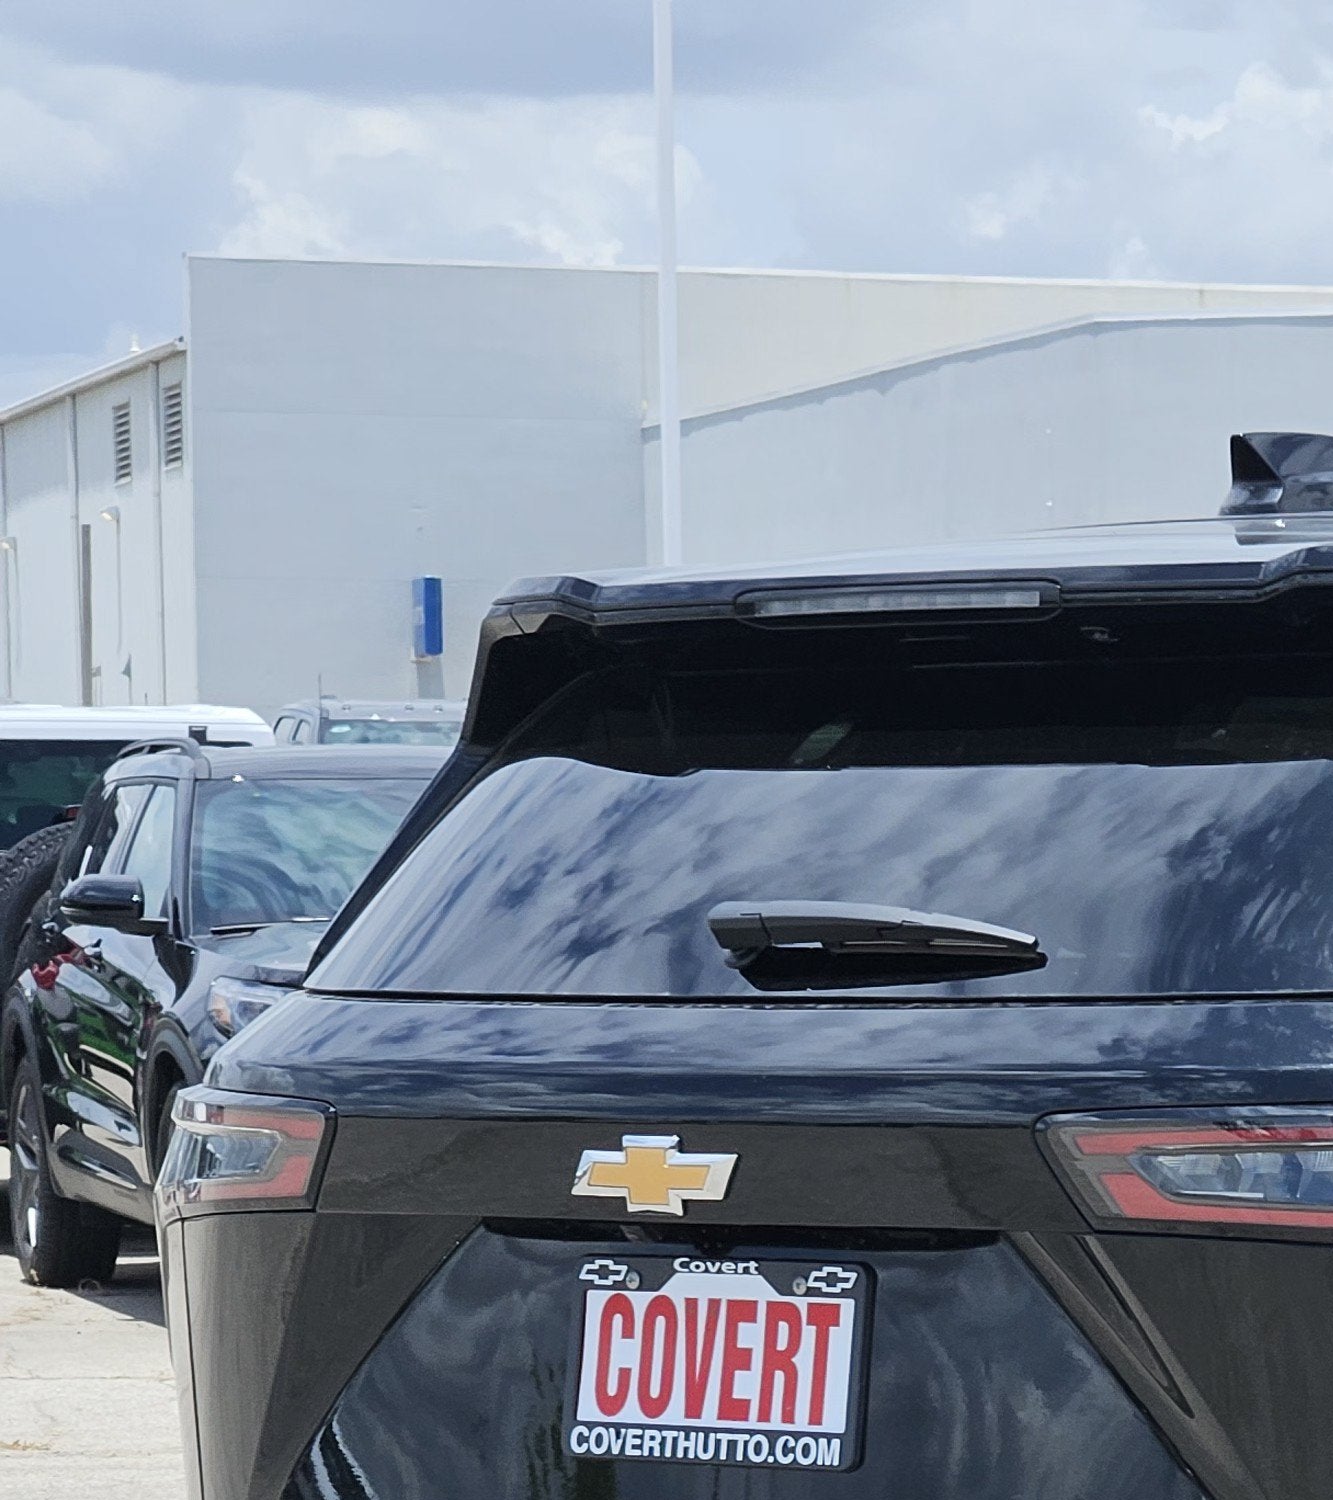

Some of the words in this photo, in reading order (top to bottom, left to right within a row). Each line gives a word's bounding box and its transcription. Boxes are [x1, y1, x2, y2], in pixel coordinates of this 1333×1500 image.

[672, 1257, 759, 1275] Covert
[595, 1292, 841, 1426] COVERT
[569, 1426, 841, 1467] COVERTHUTTO.COM
